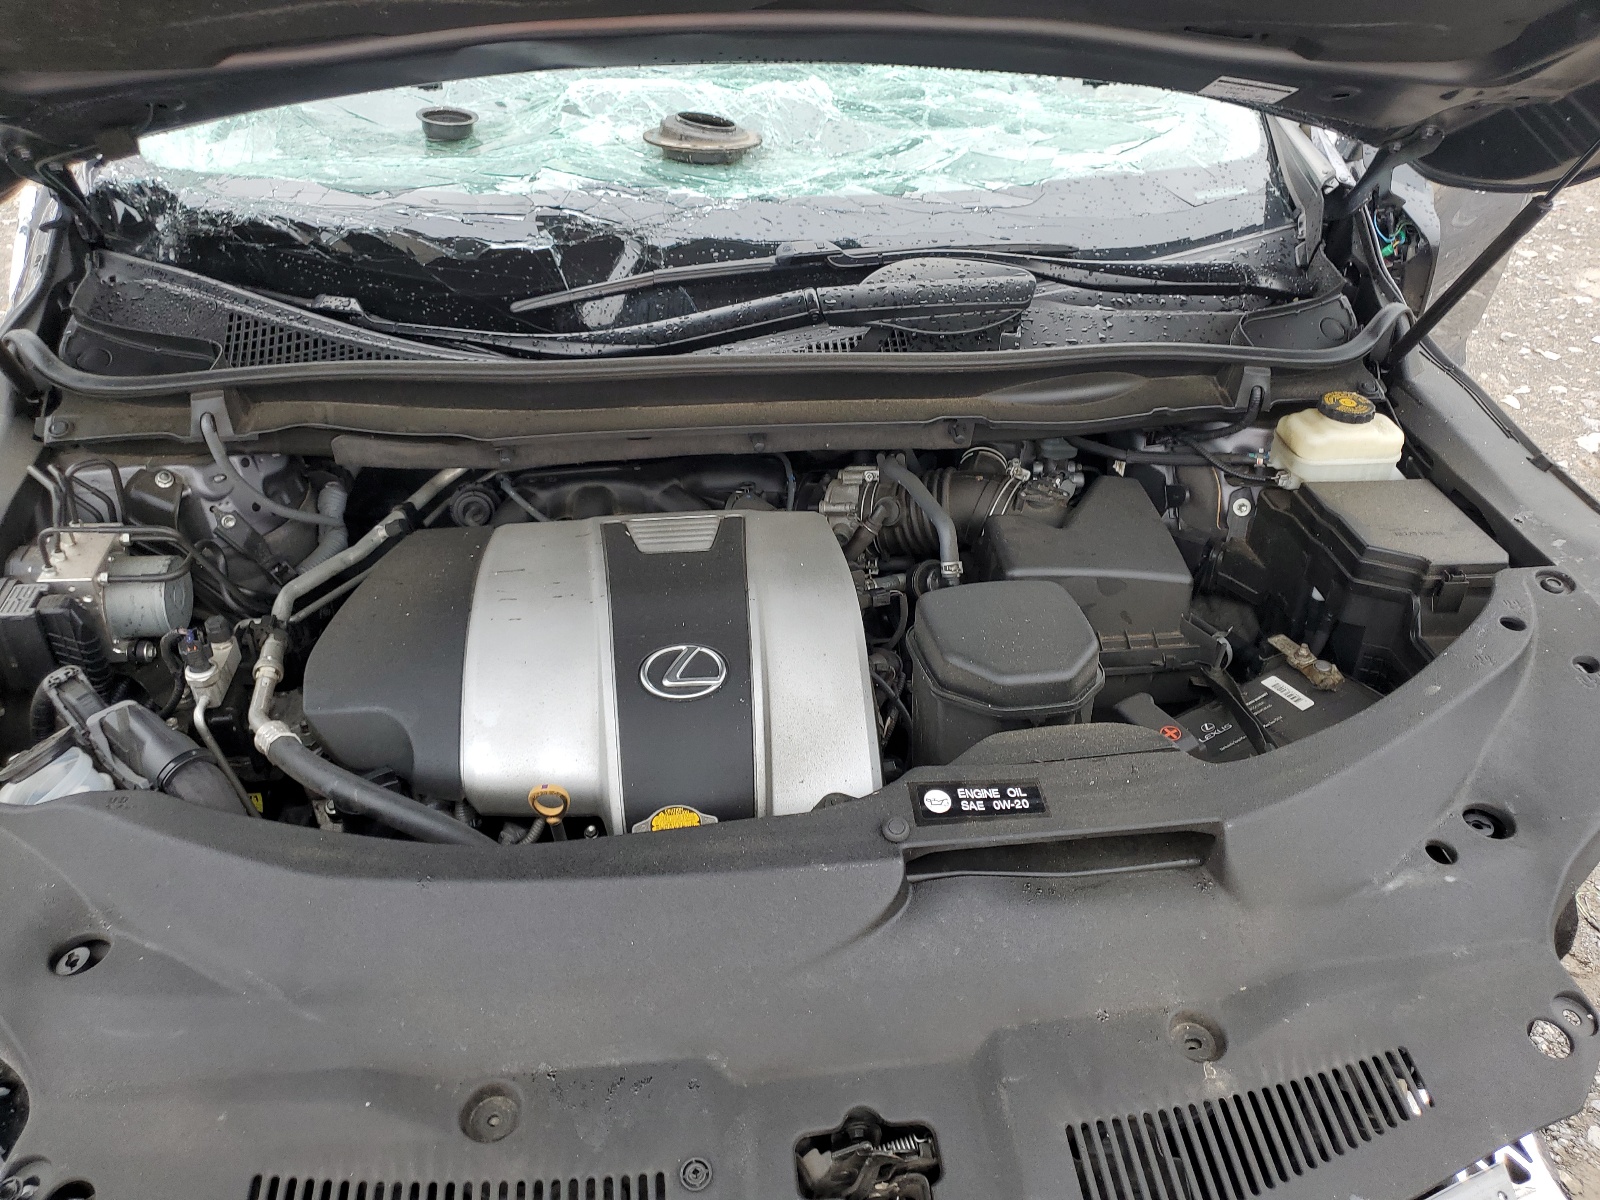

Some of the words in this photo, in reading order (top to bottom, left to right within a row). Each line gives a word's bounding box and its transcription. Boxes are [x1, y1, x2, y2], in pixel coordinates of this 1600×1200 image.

[1198, 723, 1233, 743] LEXUS
[957, 788, 1000, 799] ENGINE
[1006, 787, 1027, 798] OIL
[961, 800, 986, 811] SAE
[992, 799, 1030, 810] 0W-20
